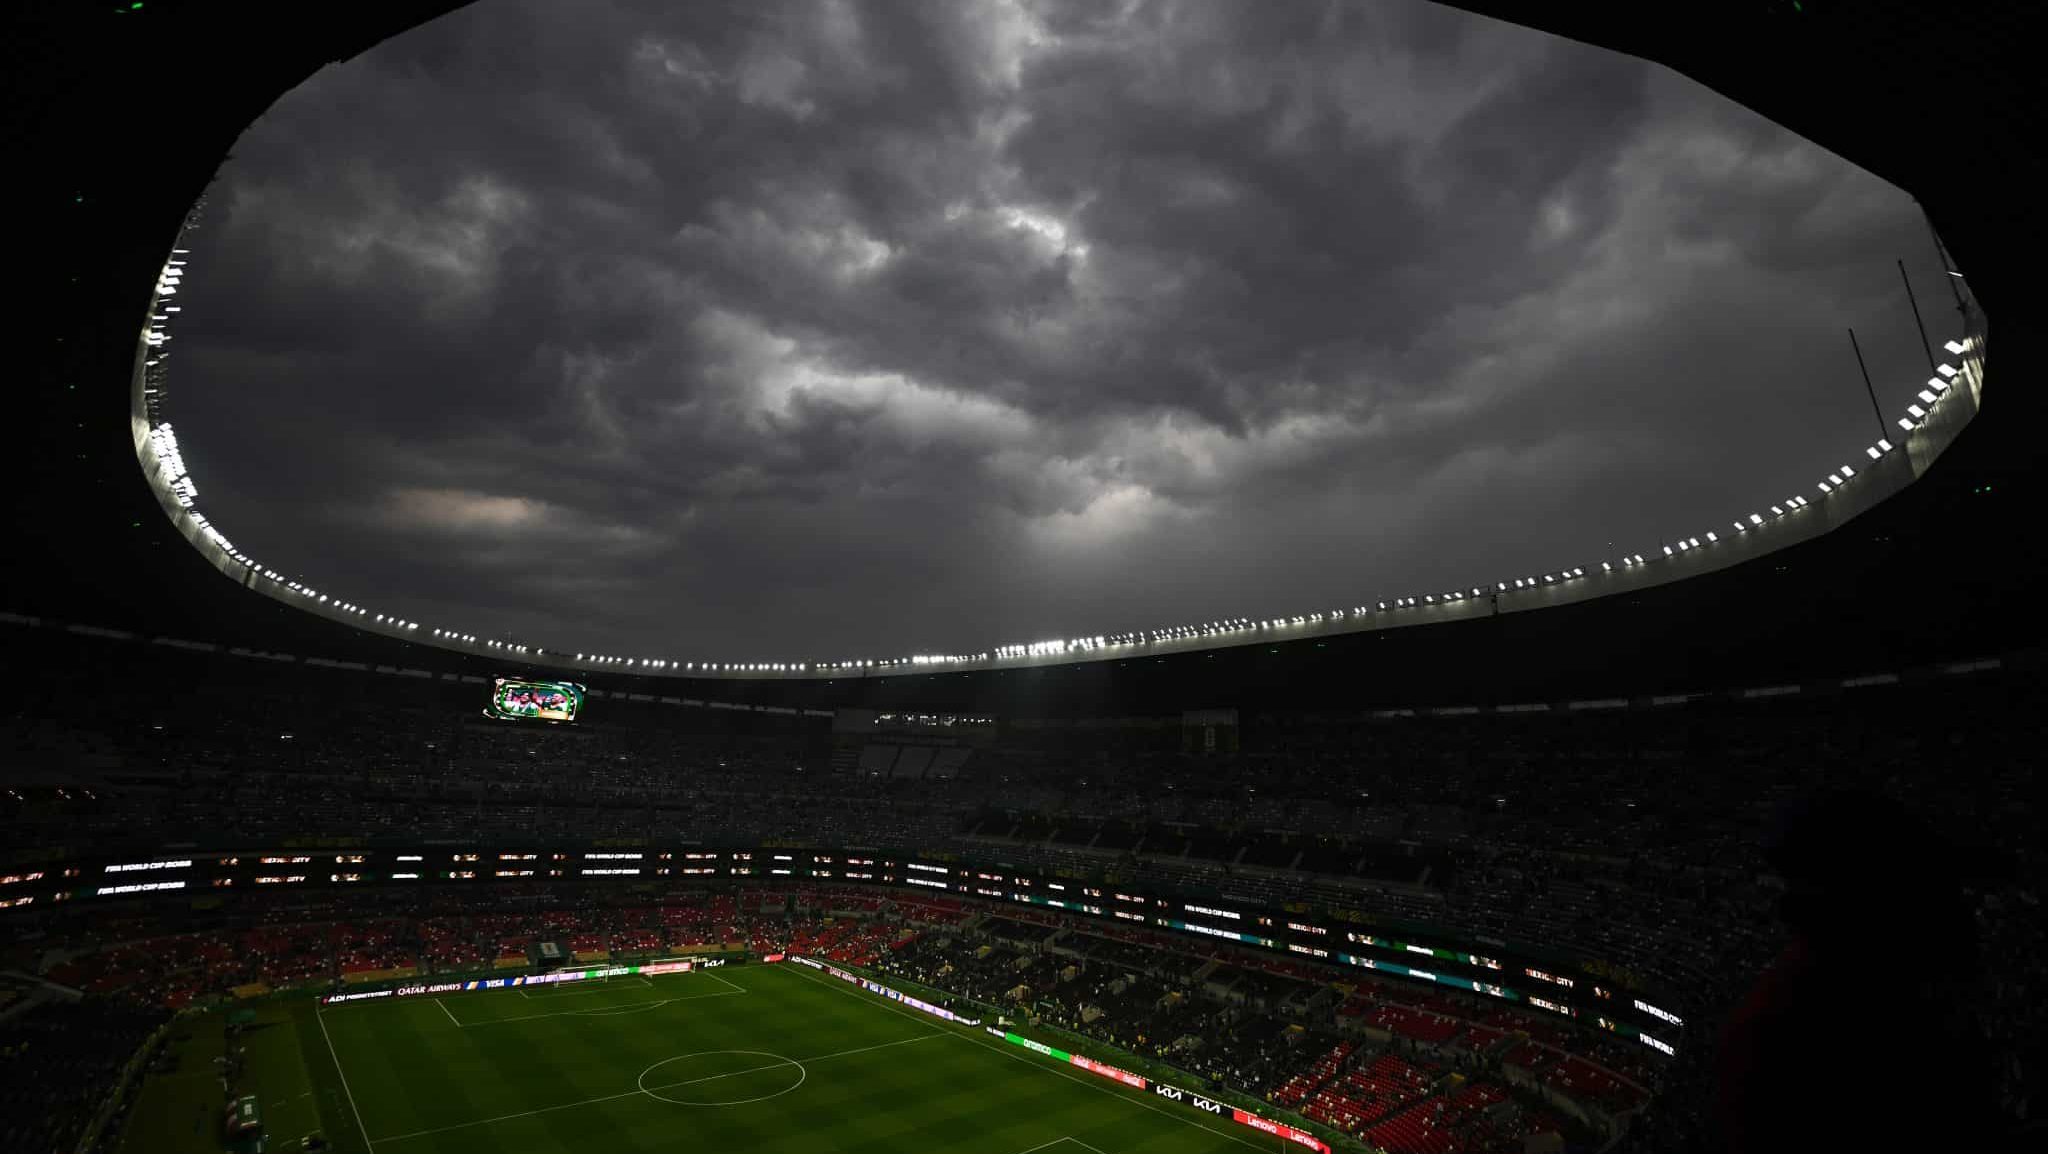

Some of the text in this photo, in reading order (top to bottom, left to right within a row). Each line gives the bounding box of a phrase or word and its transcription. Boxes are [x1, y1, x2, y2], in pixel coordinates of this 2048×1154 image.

[397, 982, 462, 997] QATAR AIRWAYS
[1648, 1005, 1669, 1021] WORLD
[1247, 1115, 1277, 1134] Lenovo
